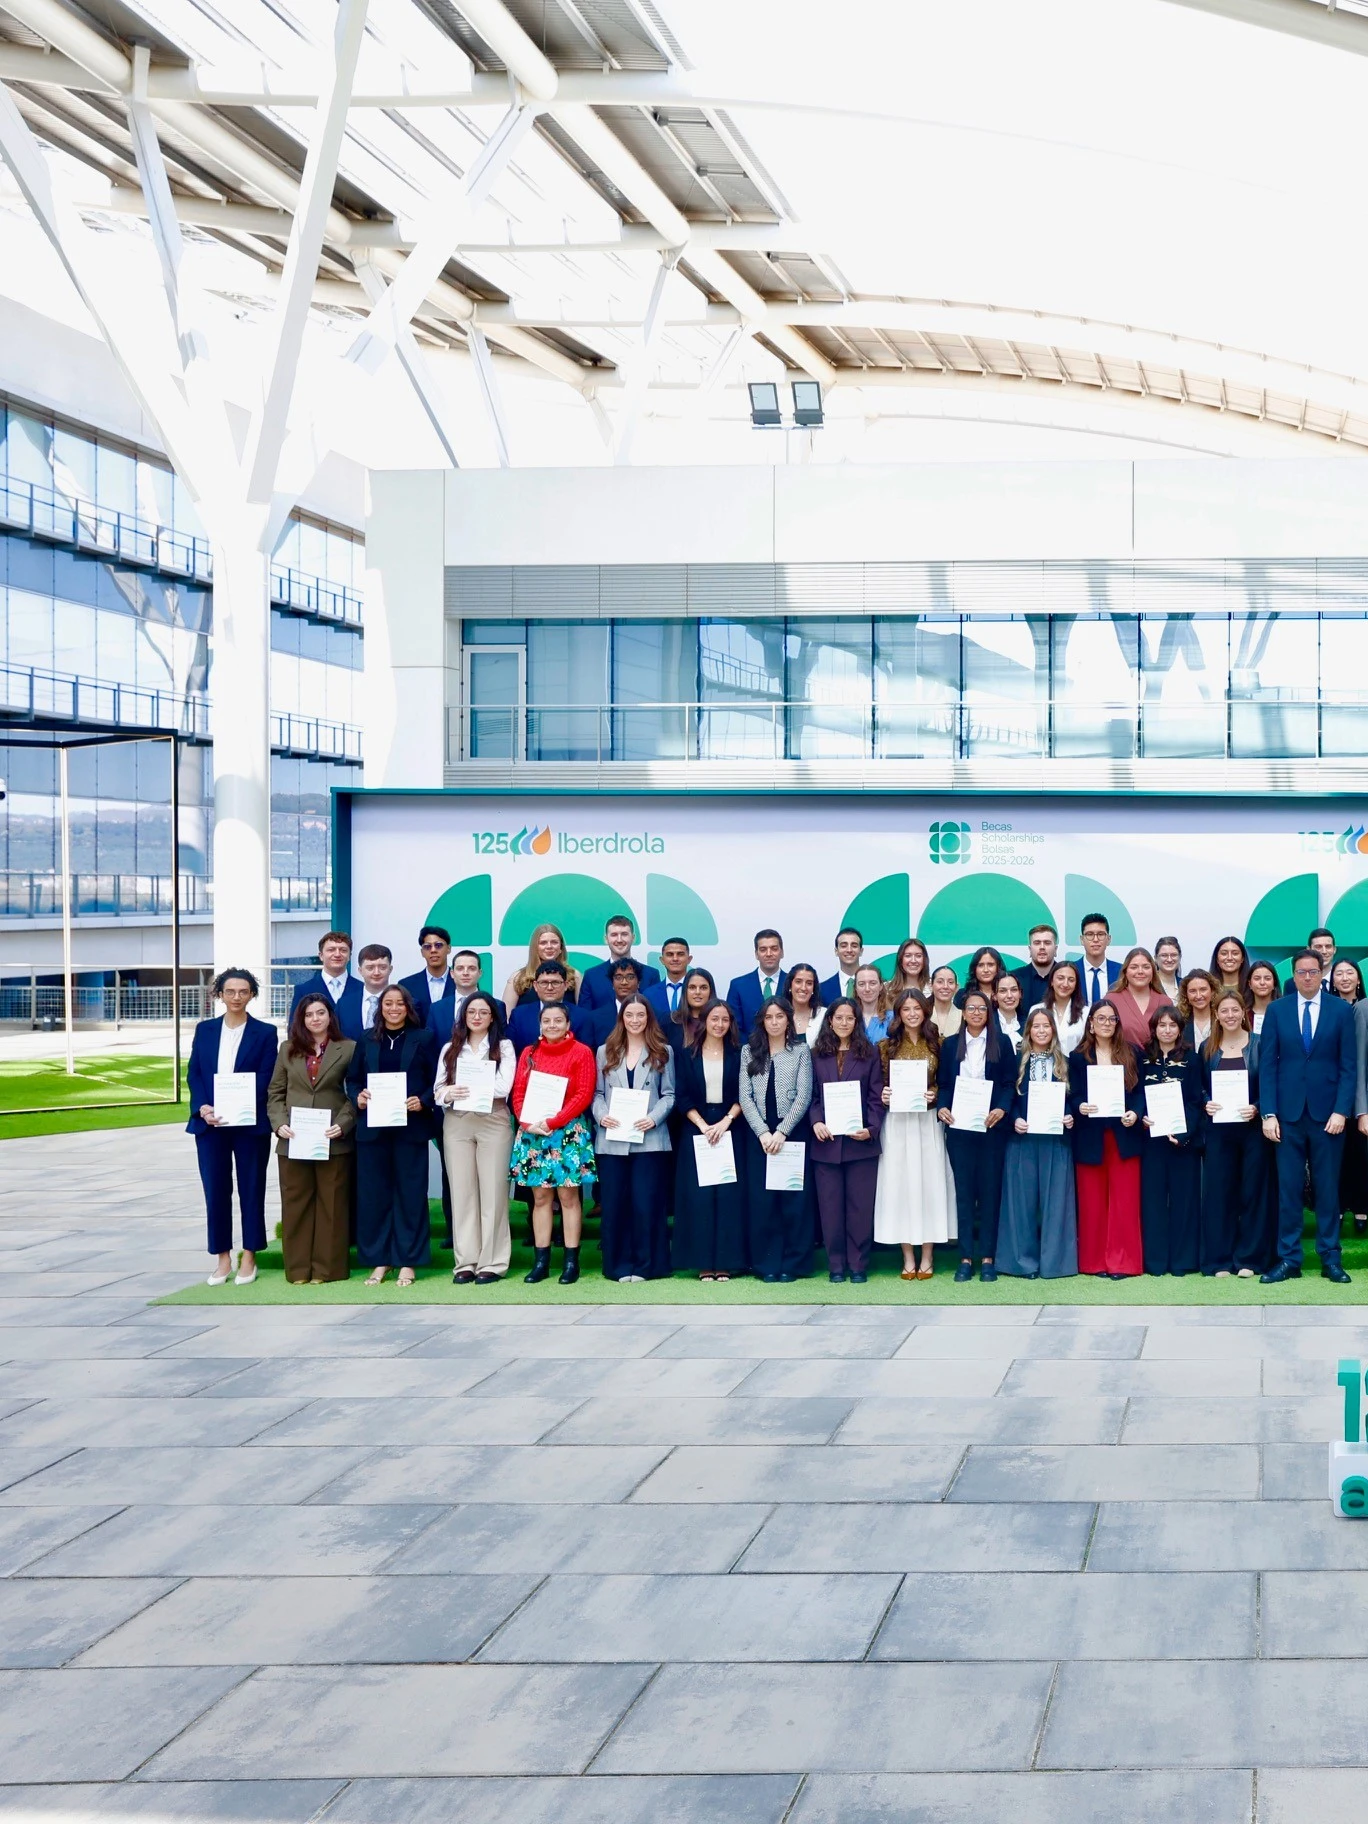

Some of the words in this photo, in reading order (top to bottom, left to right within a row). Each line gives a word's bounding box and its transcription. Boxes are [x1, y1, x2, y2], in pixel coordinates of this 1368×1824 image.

[981, 821, 1013, 831] Becas
[472, 832, 509, 854] 125
[558, 832, 665, 854] Iberdrola
[981, 832, 1045, 844] Scholarships
[981, 844, 1015, 854] Bolsas
[981, 855, 1035, 866] 2025-2026
